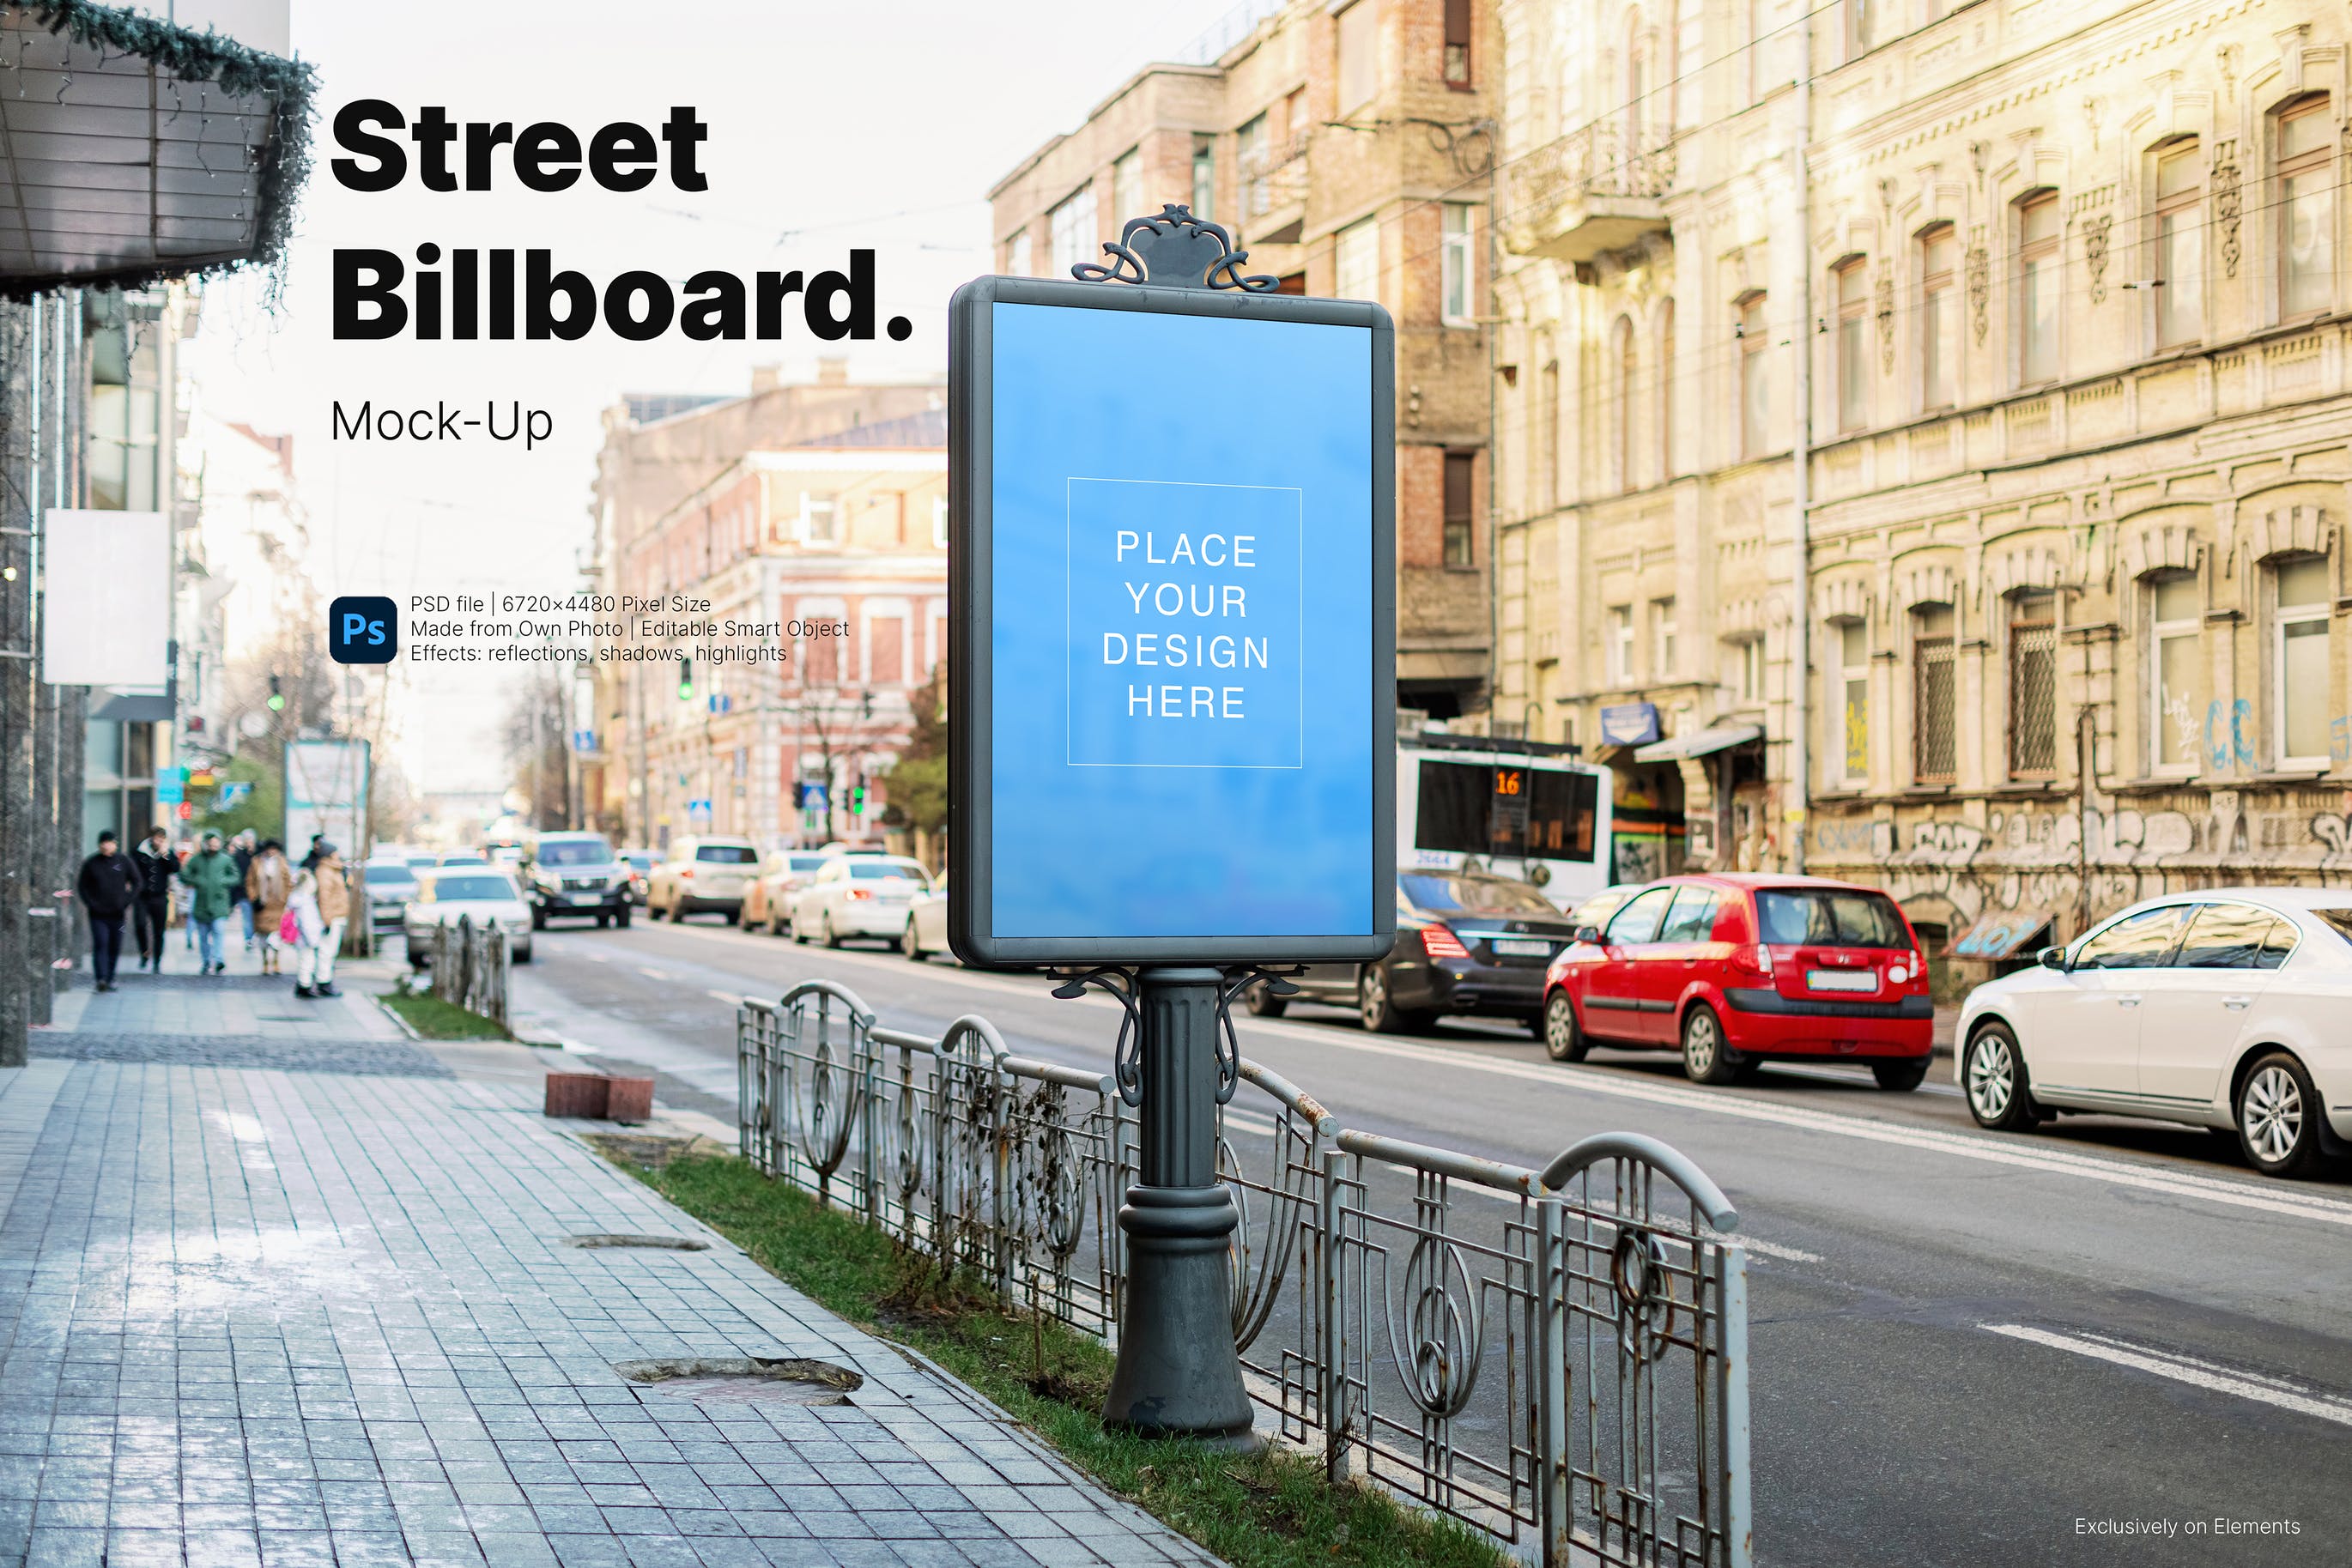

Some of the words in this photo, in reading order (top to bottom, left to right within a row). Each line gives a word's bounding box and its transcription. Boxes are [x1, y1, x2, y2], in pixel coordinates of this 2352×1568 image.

[1116, 530, 1257, 568] PLACE
[1124, 581, 1247, 618] YOUR
[1103, 632, 1269, 669] DESIGN
[1128, 684, 1245, 719] HERE
[1495, 771, 1521, 796] 16
